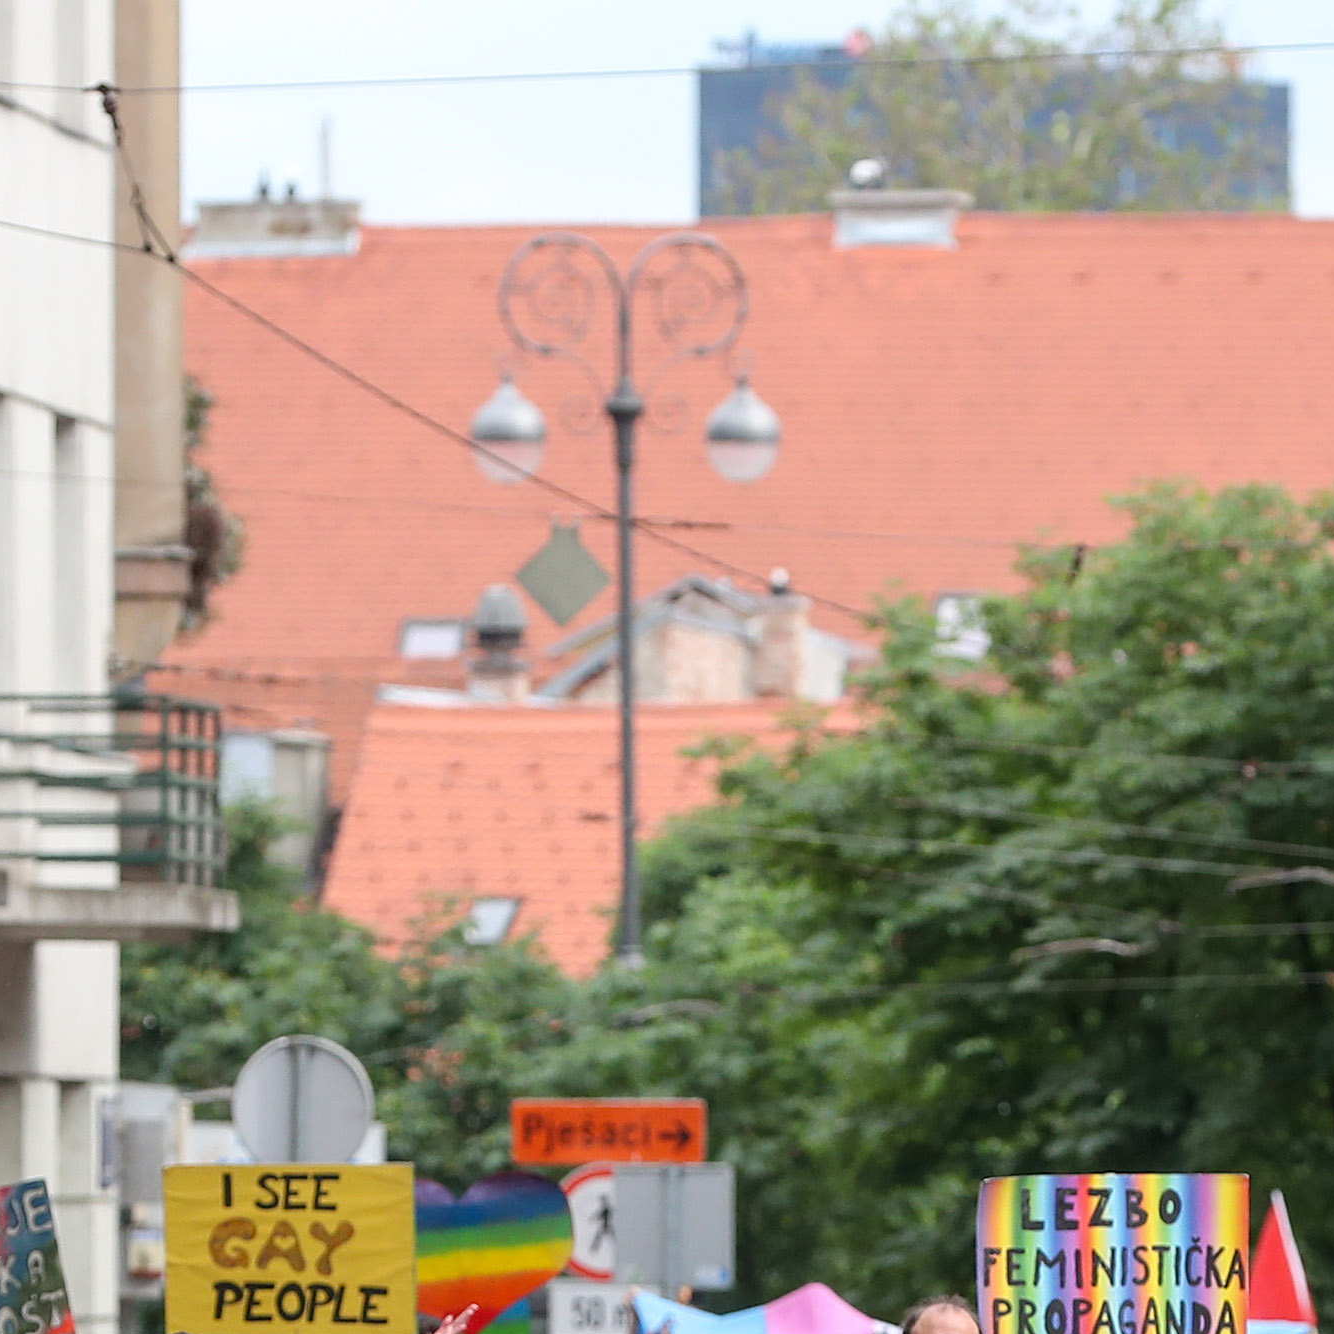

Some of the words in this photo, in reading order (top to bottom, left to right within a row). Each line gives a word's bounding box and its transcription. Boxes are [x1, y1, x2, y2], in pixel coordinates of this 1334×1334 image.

[522, 1112, 651, 1157] Pješaci
[223, 1173, 232, 1208] I
[255, 1173, 340, 1211] SEE
[1020, 1188, 1182, 1230] LEZBO
[208, 1216, 355, 1276] GAY
[983, 1237, 1246, 1289] FEMINISTIČKA
[214, 1281, 388, 1324] PEOPLE
